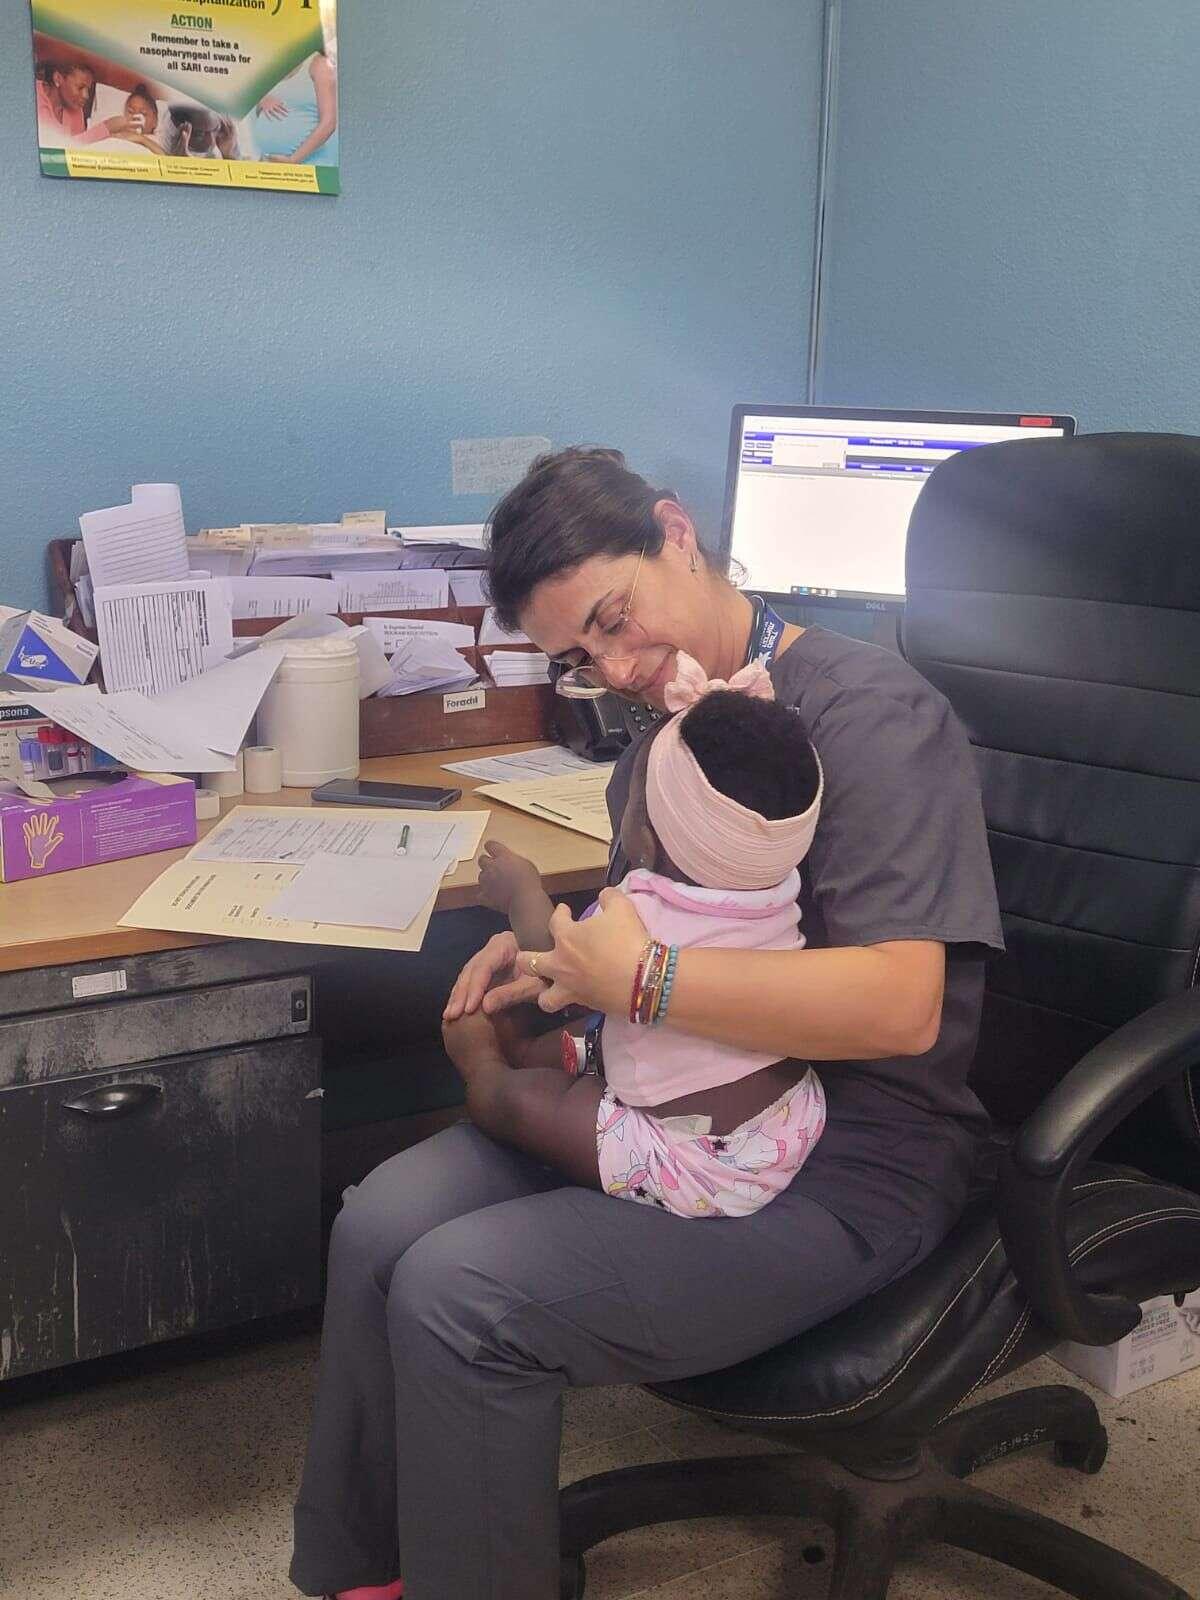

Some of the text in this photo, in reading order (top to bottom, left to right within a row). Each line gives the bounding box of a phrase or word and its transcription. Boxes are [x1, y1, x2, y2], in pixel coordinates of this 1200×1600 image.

[171, 14, 213, 28] ACTION
[151, 33, 198, 46] Remember
[201, 38, 210, 47] to
[212, 39, 231, 49] take
[139, 46, 251, 63] nasopharyngeal swab for
[167, 61, 229, 75] all SARI cases
